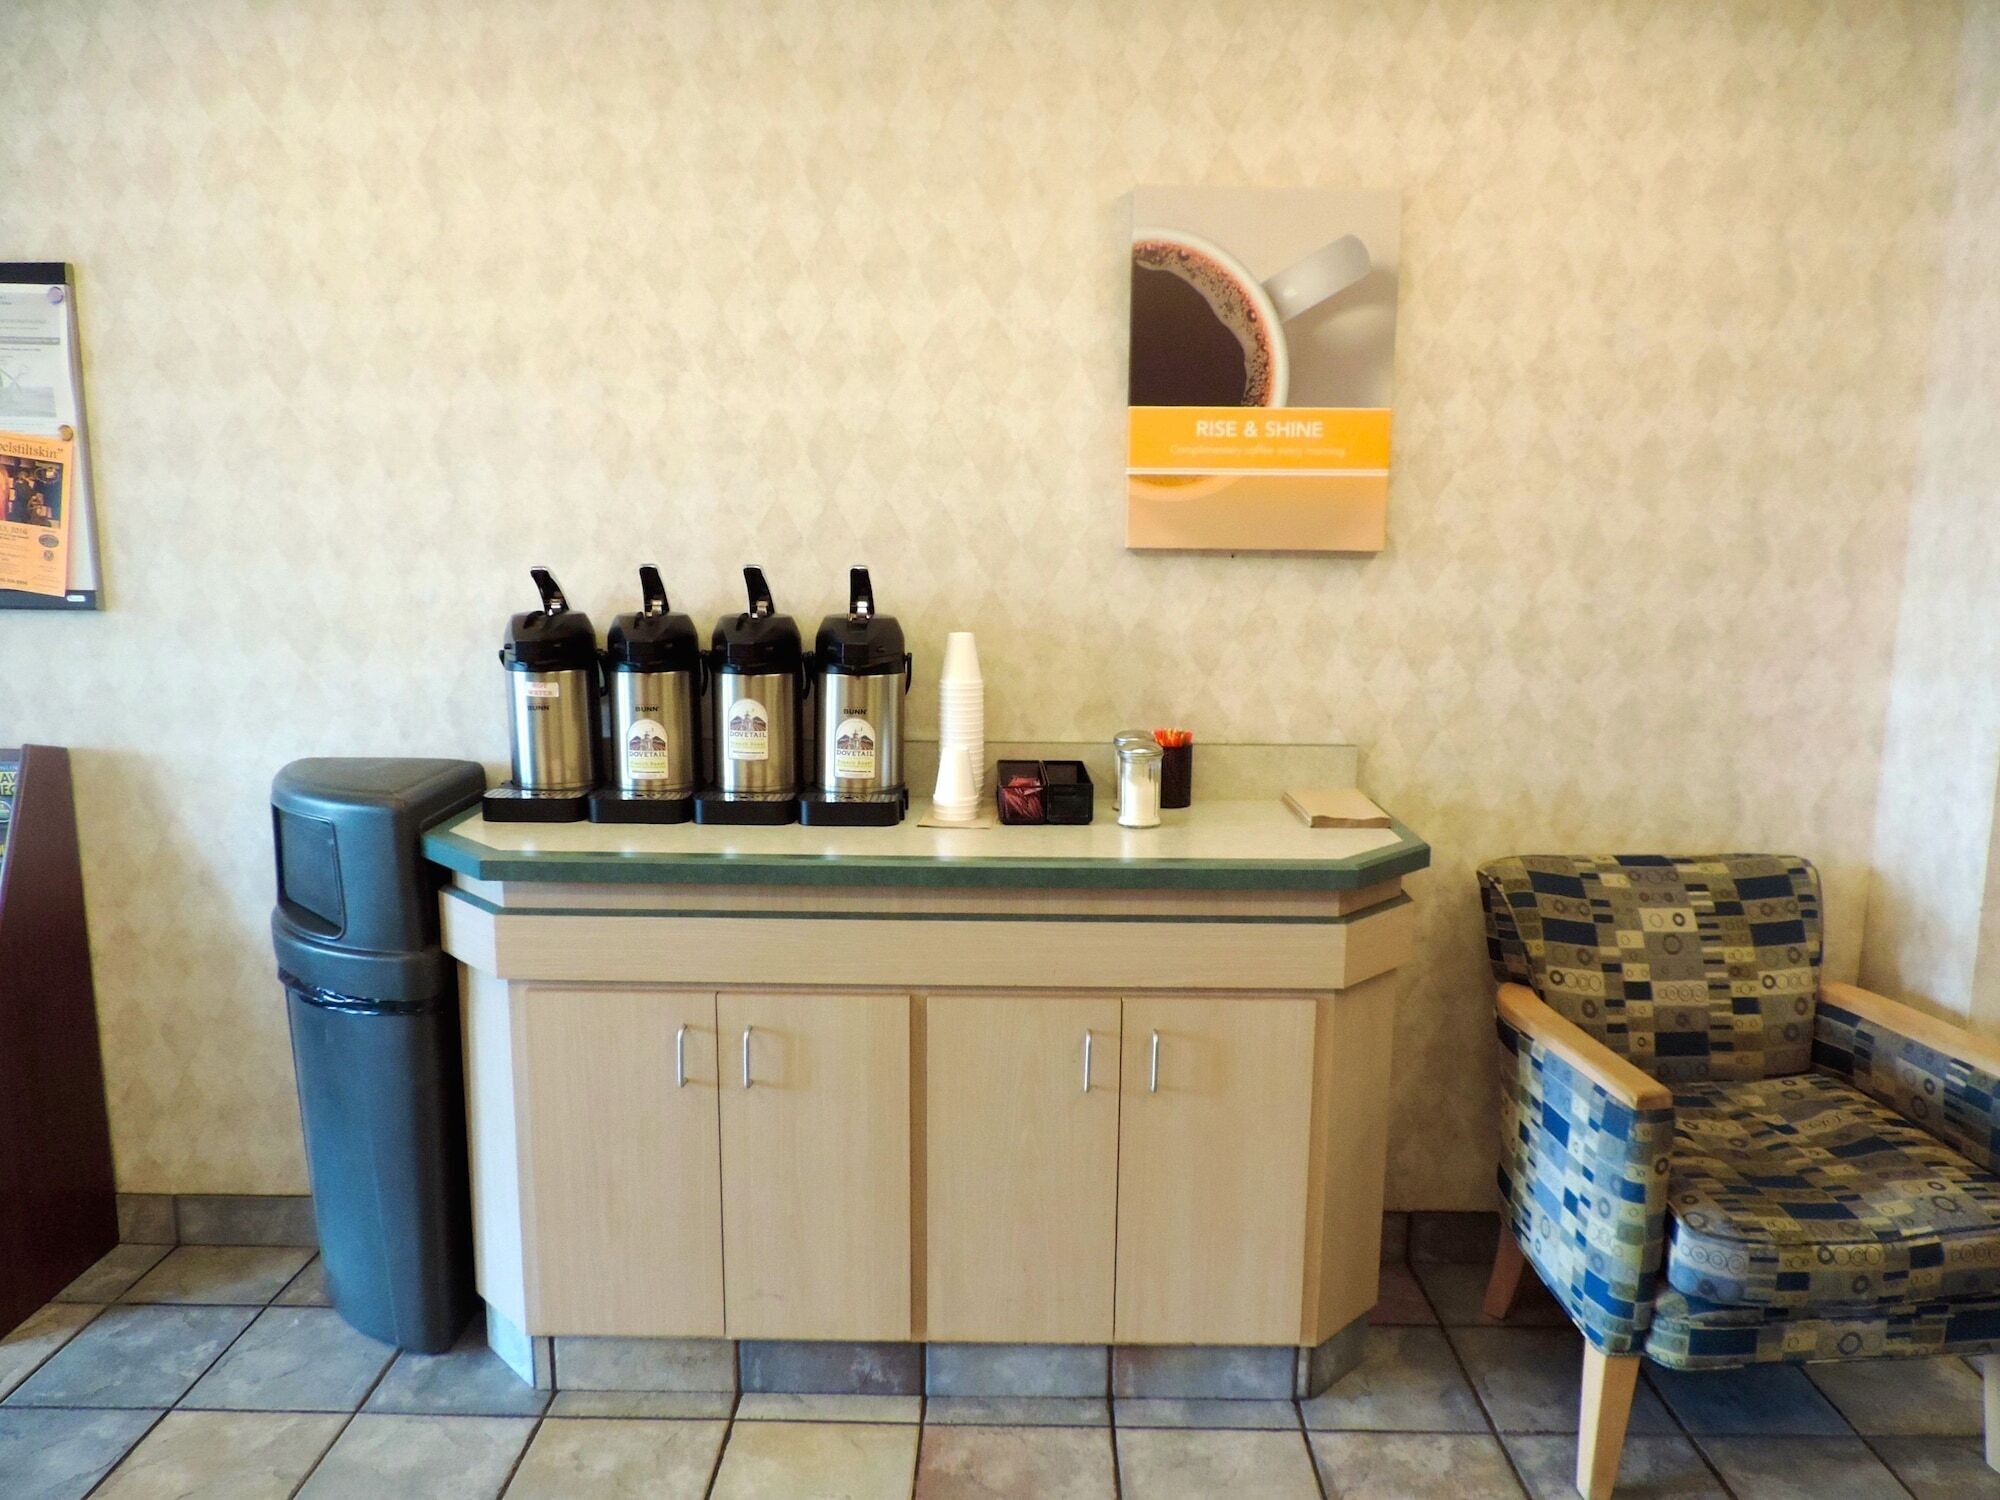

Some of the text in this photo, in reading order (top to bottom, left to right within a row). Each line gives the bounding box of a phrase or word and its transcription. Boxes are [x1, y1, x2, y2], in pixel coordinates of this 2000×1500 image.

[1196, 420, 1324, 438] RISE & SHINE
